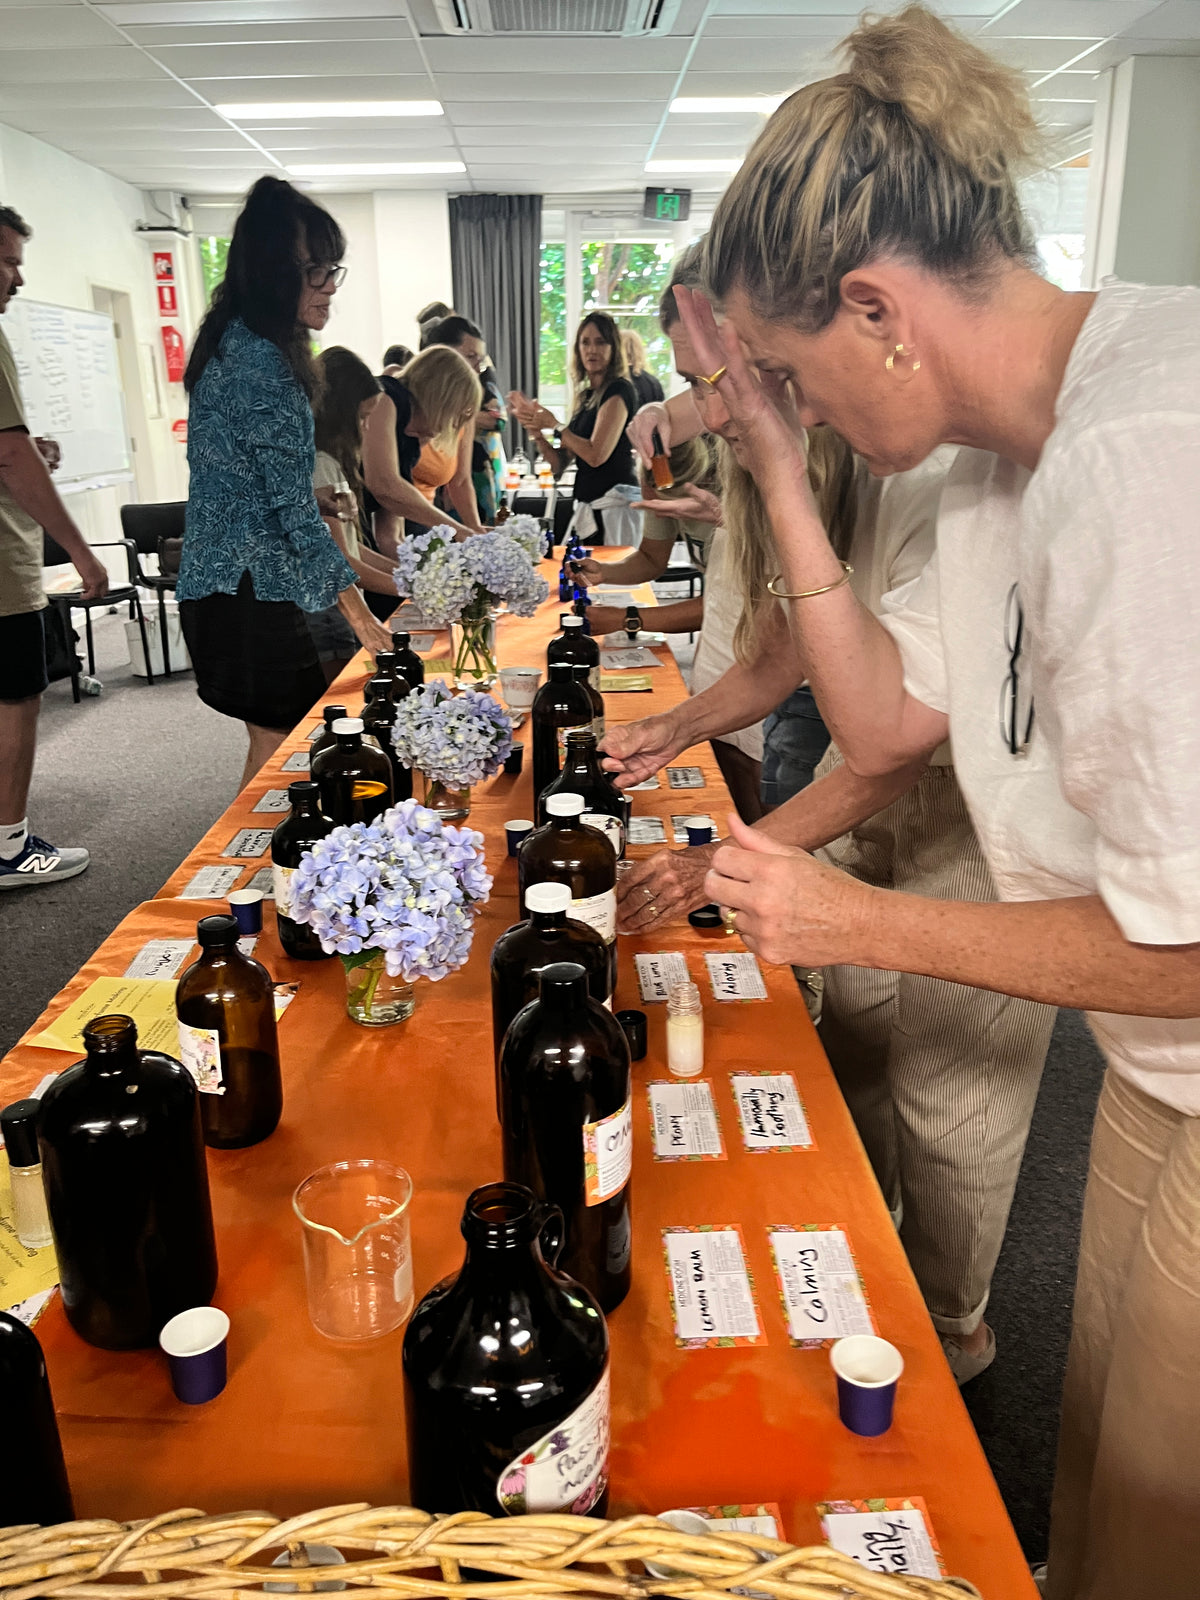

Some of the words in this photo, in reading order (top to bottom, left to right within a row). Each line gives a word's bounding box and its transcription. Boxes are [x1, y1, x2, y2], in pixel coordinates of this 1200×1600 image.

[669, 1115, 687, 1147] PEONY
[689, 1249, 704, 1283] BALM
[792, 1248, 828, 1323] Calming
[697, 1289, 717, 1332] LEMON
